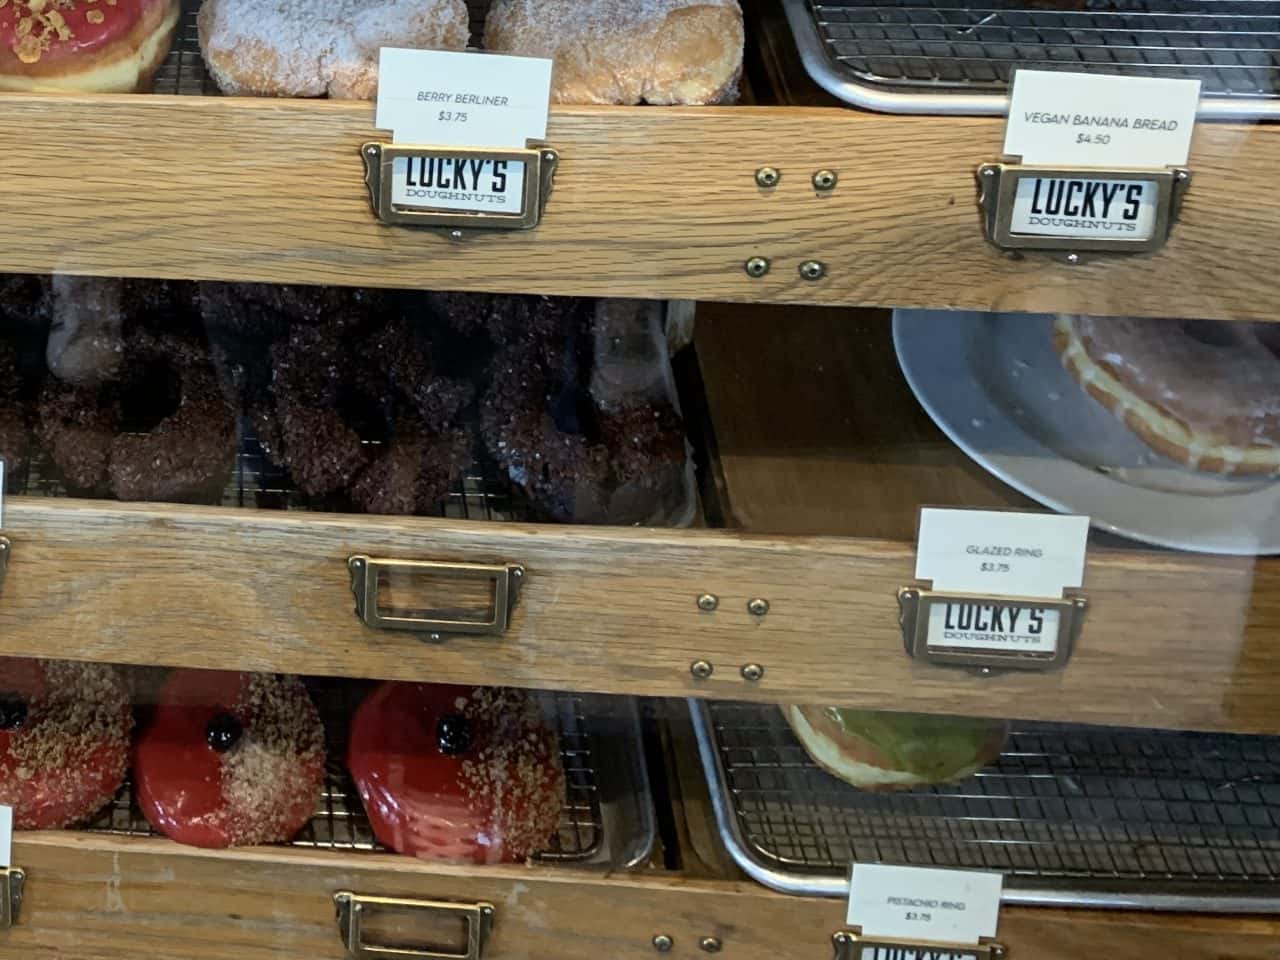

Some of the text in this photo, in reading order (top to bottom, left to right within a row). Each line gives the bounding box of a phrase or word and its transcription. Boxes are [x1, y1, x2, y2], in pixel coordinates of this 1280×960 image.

[417, 91, 508, 106] BERRY BERLINER
[438, 110, 468, 122] $3.75
[1024, 111, 1178, 131] VEGAN BANANA BREAD
[1076, 133, 1111, 145] $4.50
[406, 157, 508, 192] LUCKY'S
[406, 189, 506, 203] DOUGHNUTS
[1031, 179, 1143, 220] LUCKY'S
[1028, 216, 1136, 231] DOUGHNUTS
[966, 545, 1042, 558] GLAZED RING
[980, 562, 1009, 572] $3.75
[944, 603, 1043, 634] LUCKYS
[944, 631, 1040, 643] DOUGHNUTS
[887, 896, 966, 910] PISTACHIO RING
